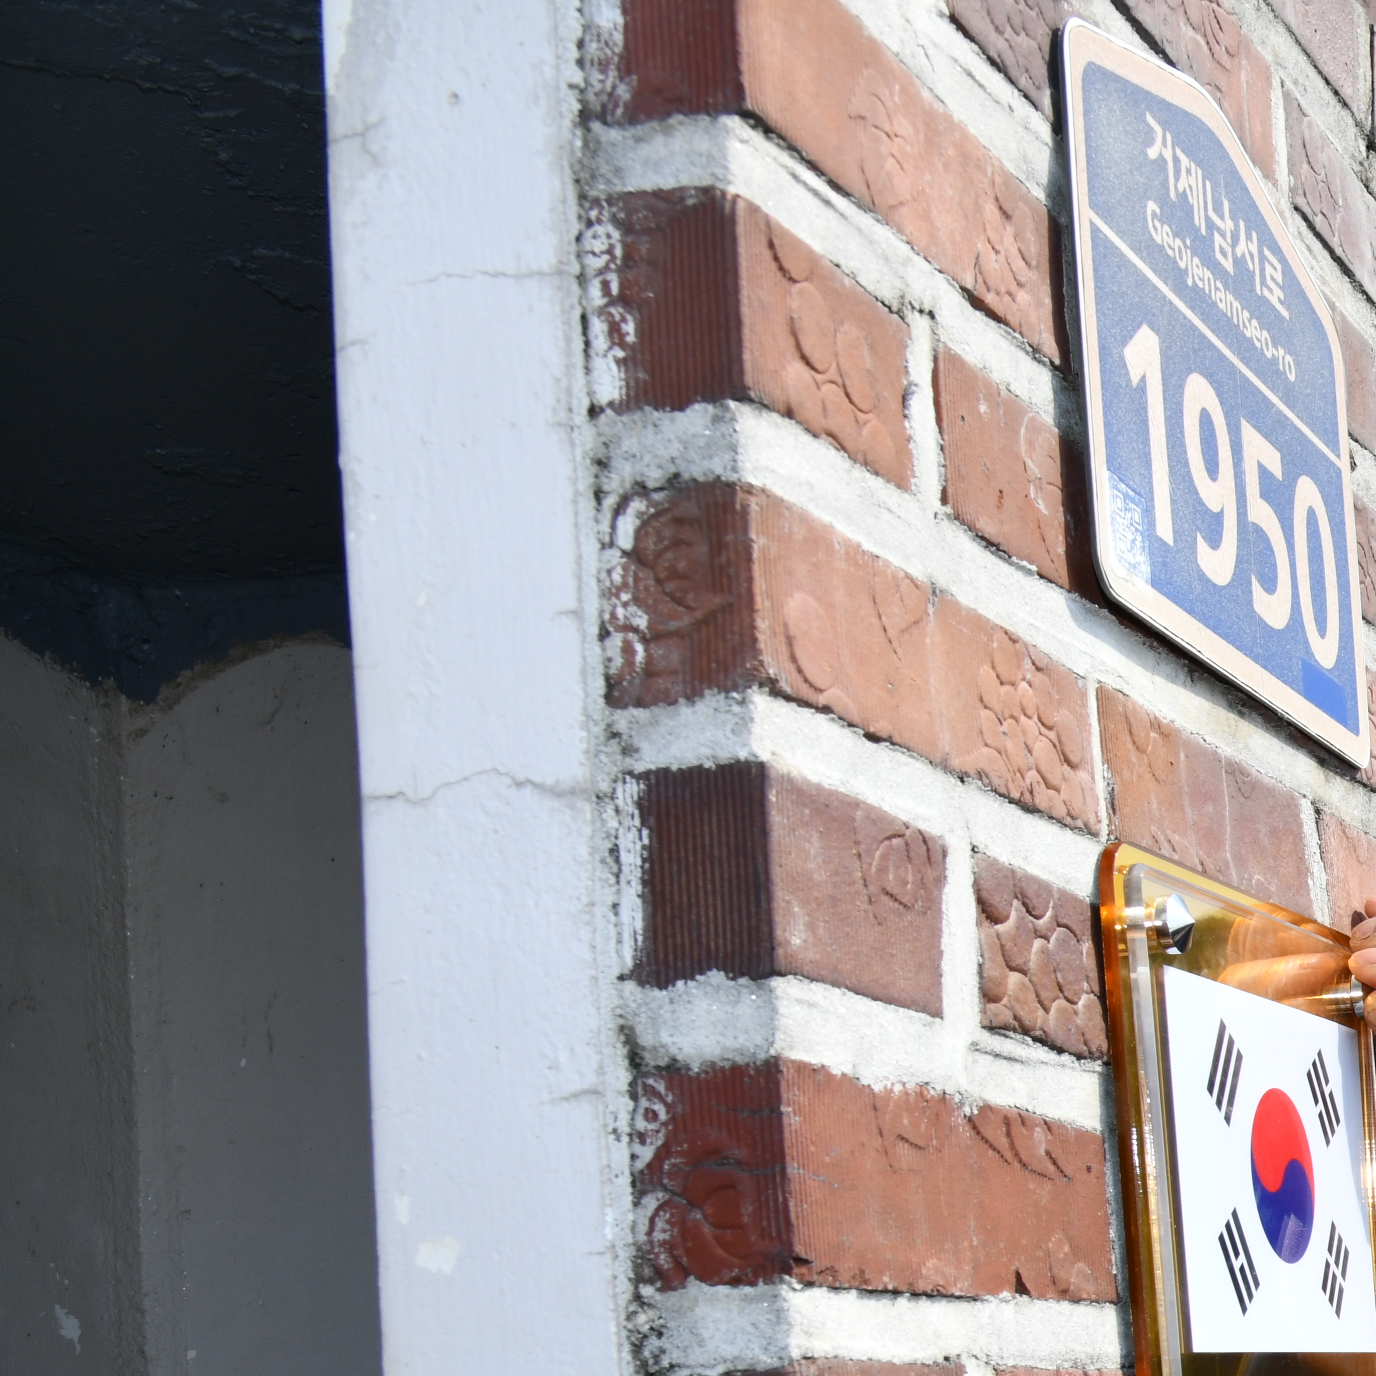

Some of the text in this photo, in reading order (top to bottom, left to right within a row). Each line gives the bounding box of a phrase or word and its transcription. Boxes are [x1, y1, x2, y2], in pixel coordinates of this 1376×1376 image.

[1145, 111, 1290, 320] 거제남서로
[1146, 200, 1296, 383] Geojenamseo-ro
[1124, 323, 1340, 670] 1950
